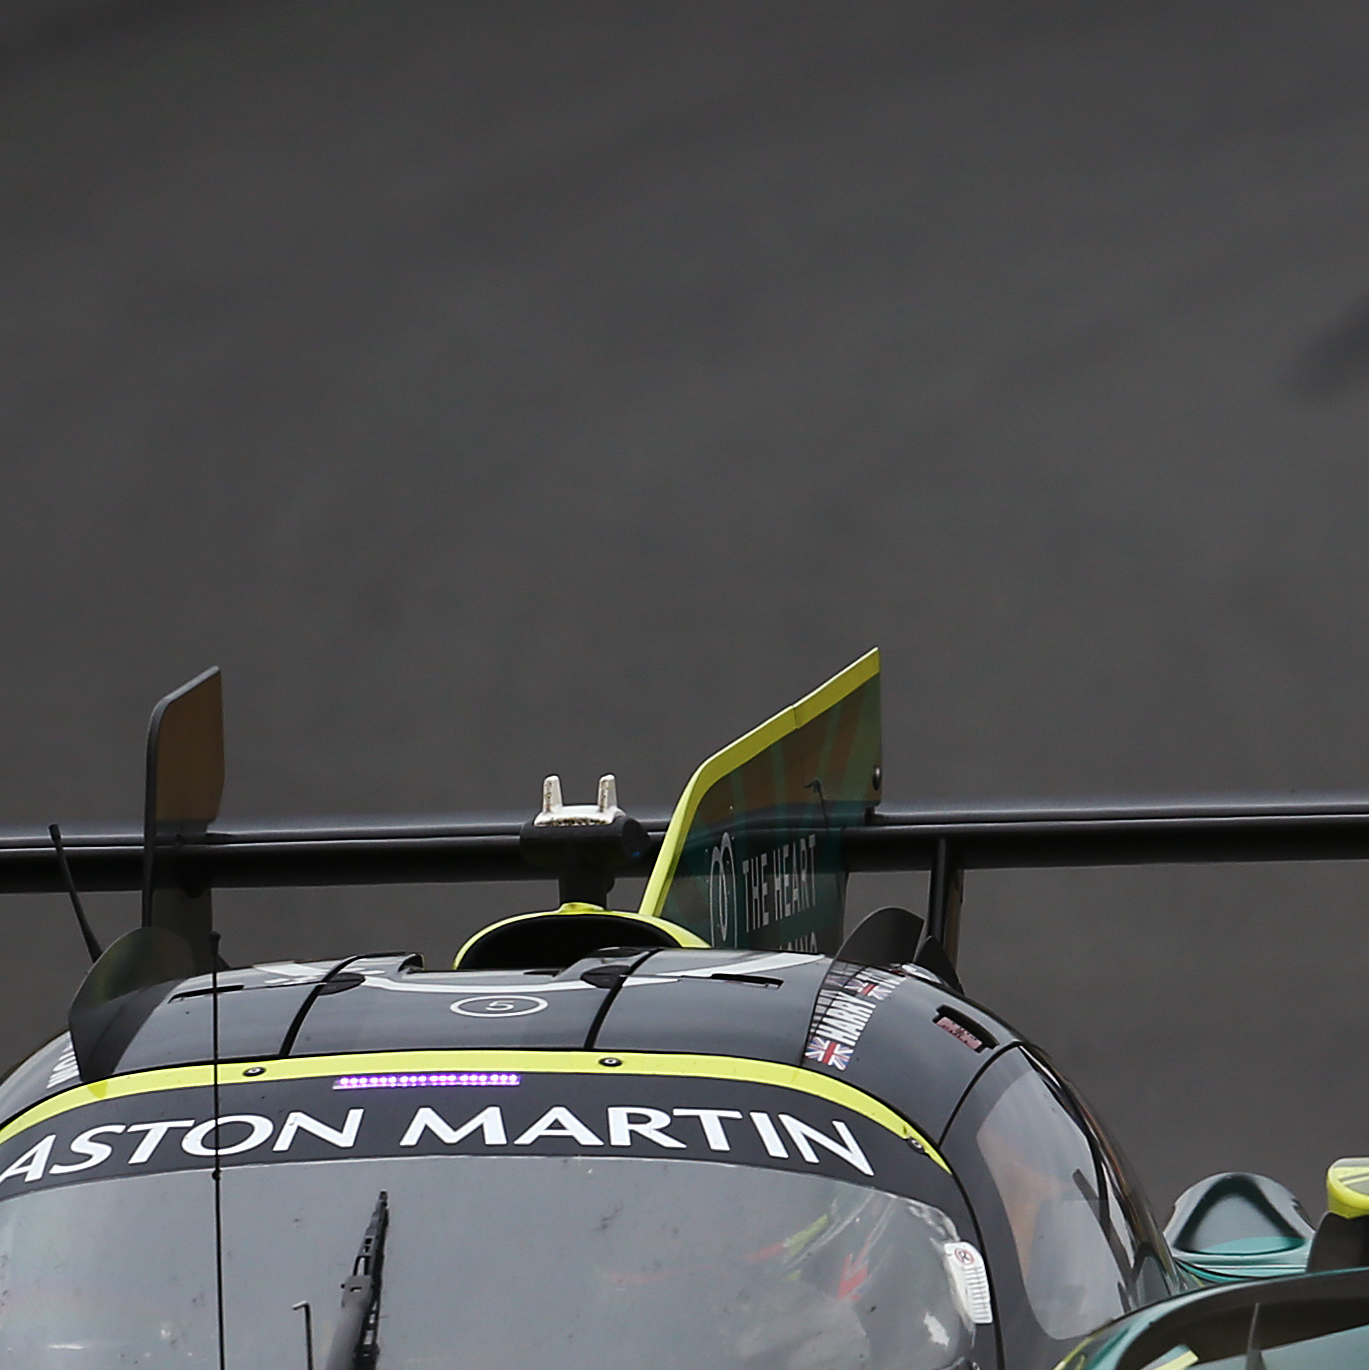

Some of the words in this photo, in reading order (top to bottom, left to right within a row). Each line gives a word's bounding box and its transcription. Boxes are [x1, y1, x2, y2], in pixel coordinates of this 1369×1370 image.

[741, 852, 770, 933] THE
[772, 833, 817, 921] HEART
[815, 991, 877, 1047] HARRY
[400, 1105, 876, 1177] MARTIN
